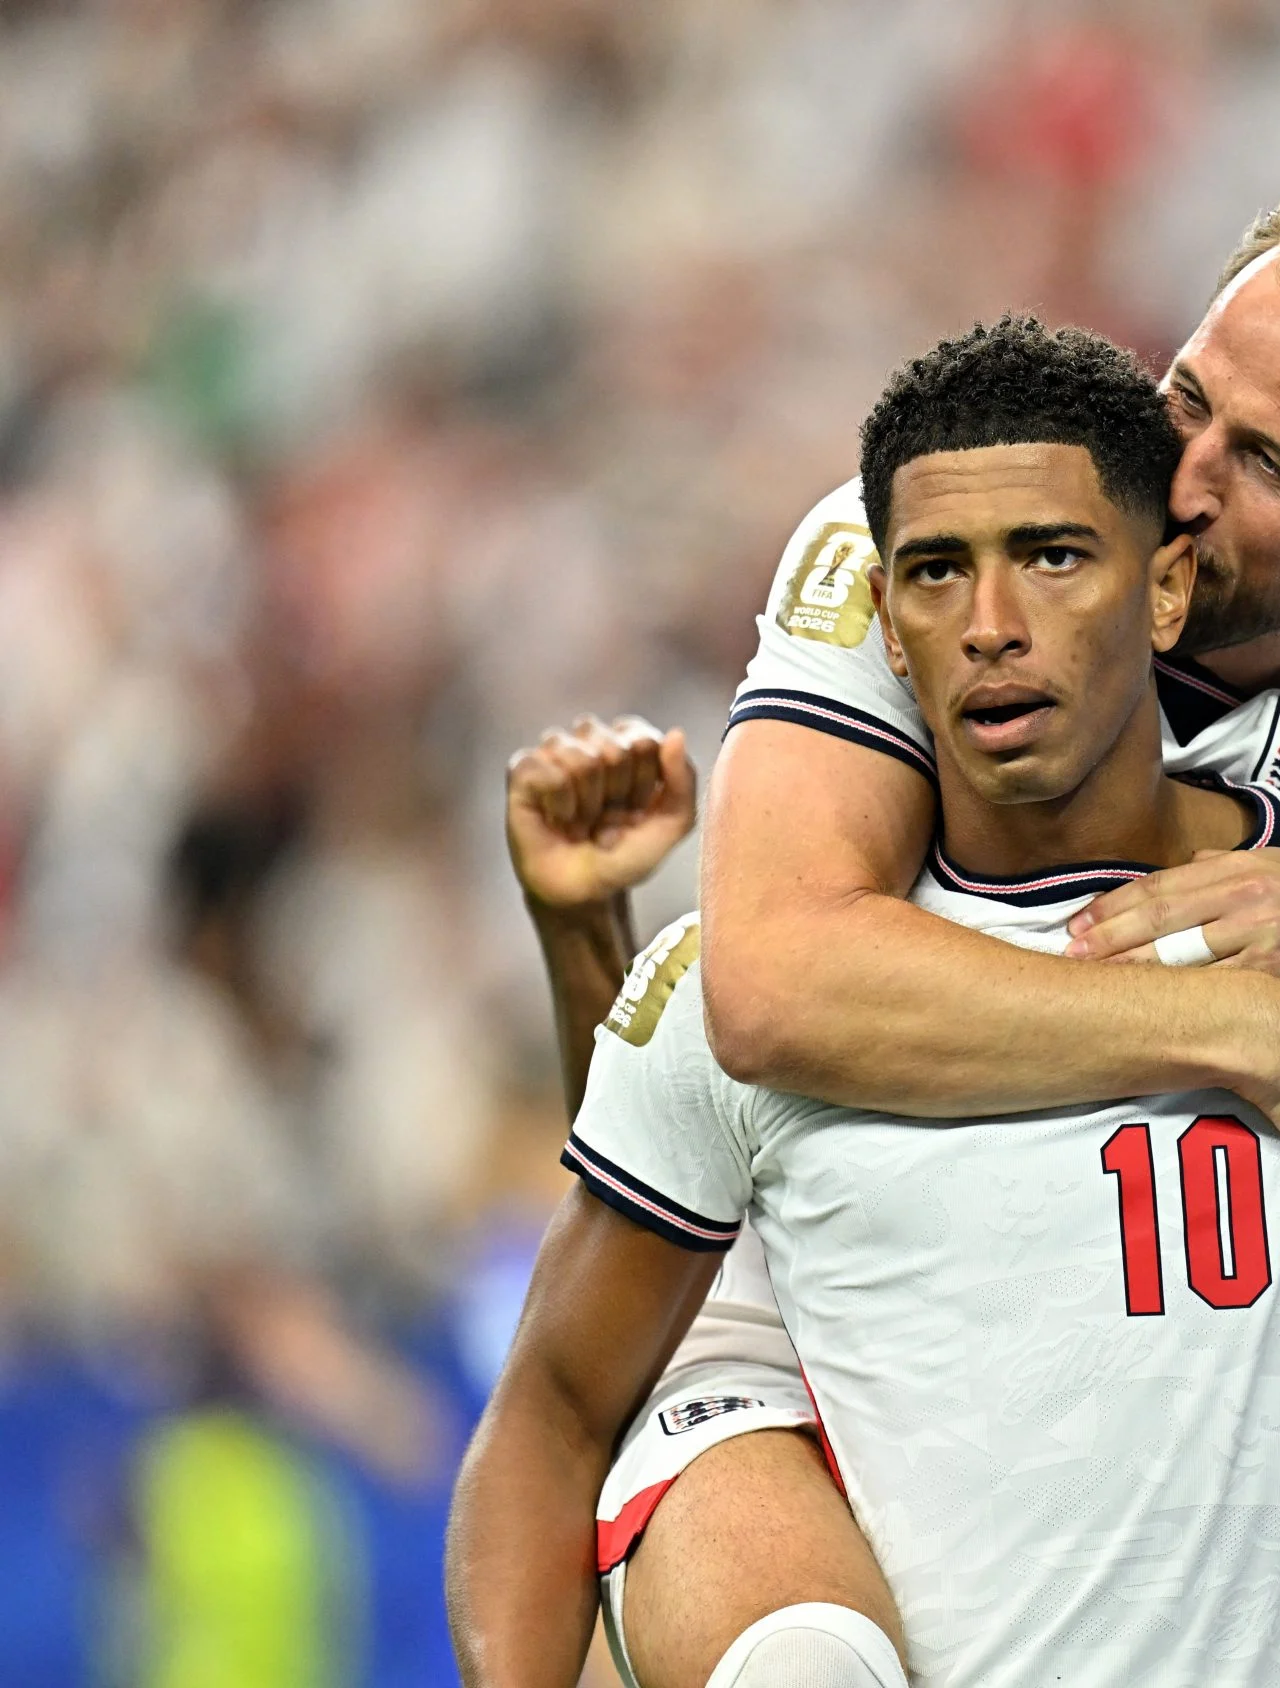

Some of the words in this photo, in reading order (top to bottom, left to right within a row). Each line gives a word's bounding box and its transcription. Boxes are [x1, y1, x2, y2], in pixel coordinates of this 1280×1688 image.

[812, 589, 833, 600] FIFA
[794, 606, 821, 617] WORLD
[822, 609, 840, 620] CUP
[787, 615, 836, 633] 2026
[1100, 1114, 1272, 1317] 10
